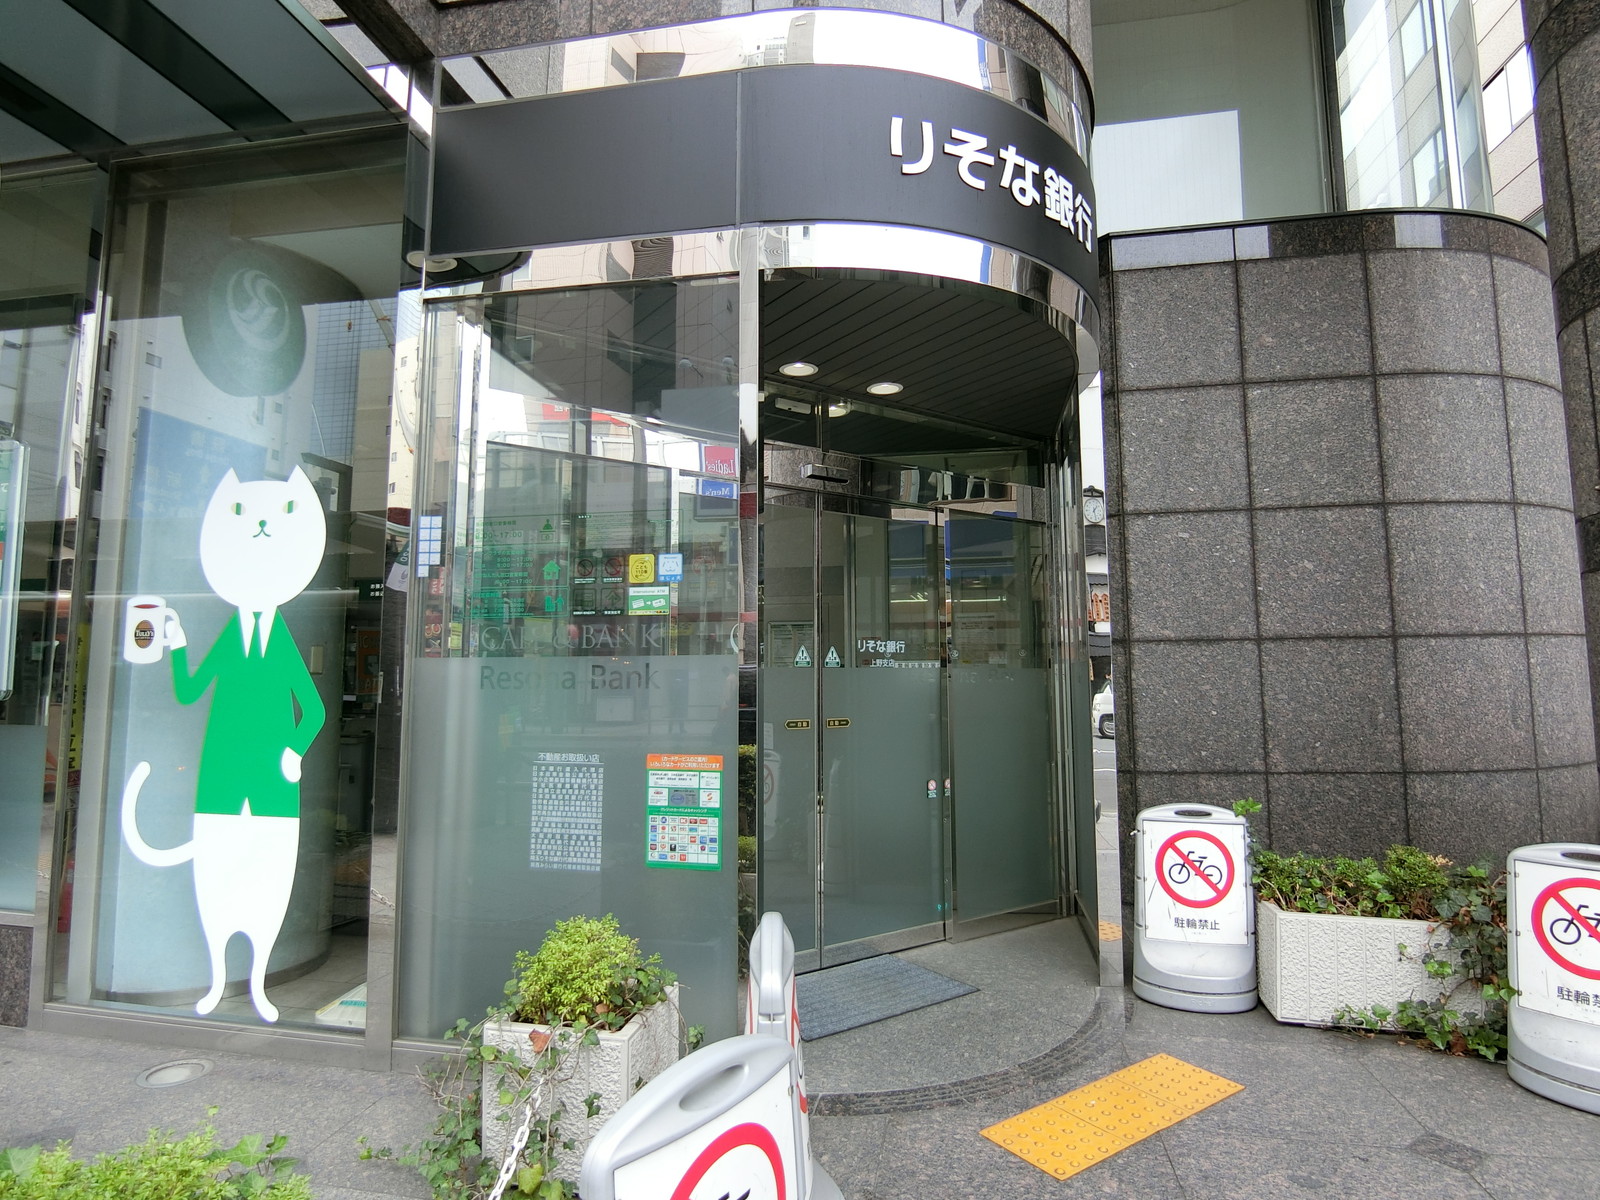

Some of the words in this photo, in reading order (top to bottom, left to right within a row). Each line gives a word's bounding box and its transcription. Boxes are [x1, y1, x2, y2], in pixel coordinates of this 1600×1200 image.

[890, 115, 1093, 254] りそな銀行
[581, 623, 663, 649] BANK
[857, 639, 906, 653] りそな銀行
[869, 658, 895, 668] 上野支店
[591, 662, 662, 690] Bank
[1174, 917, 1220, 931] 駐輪禁止
